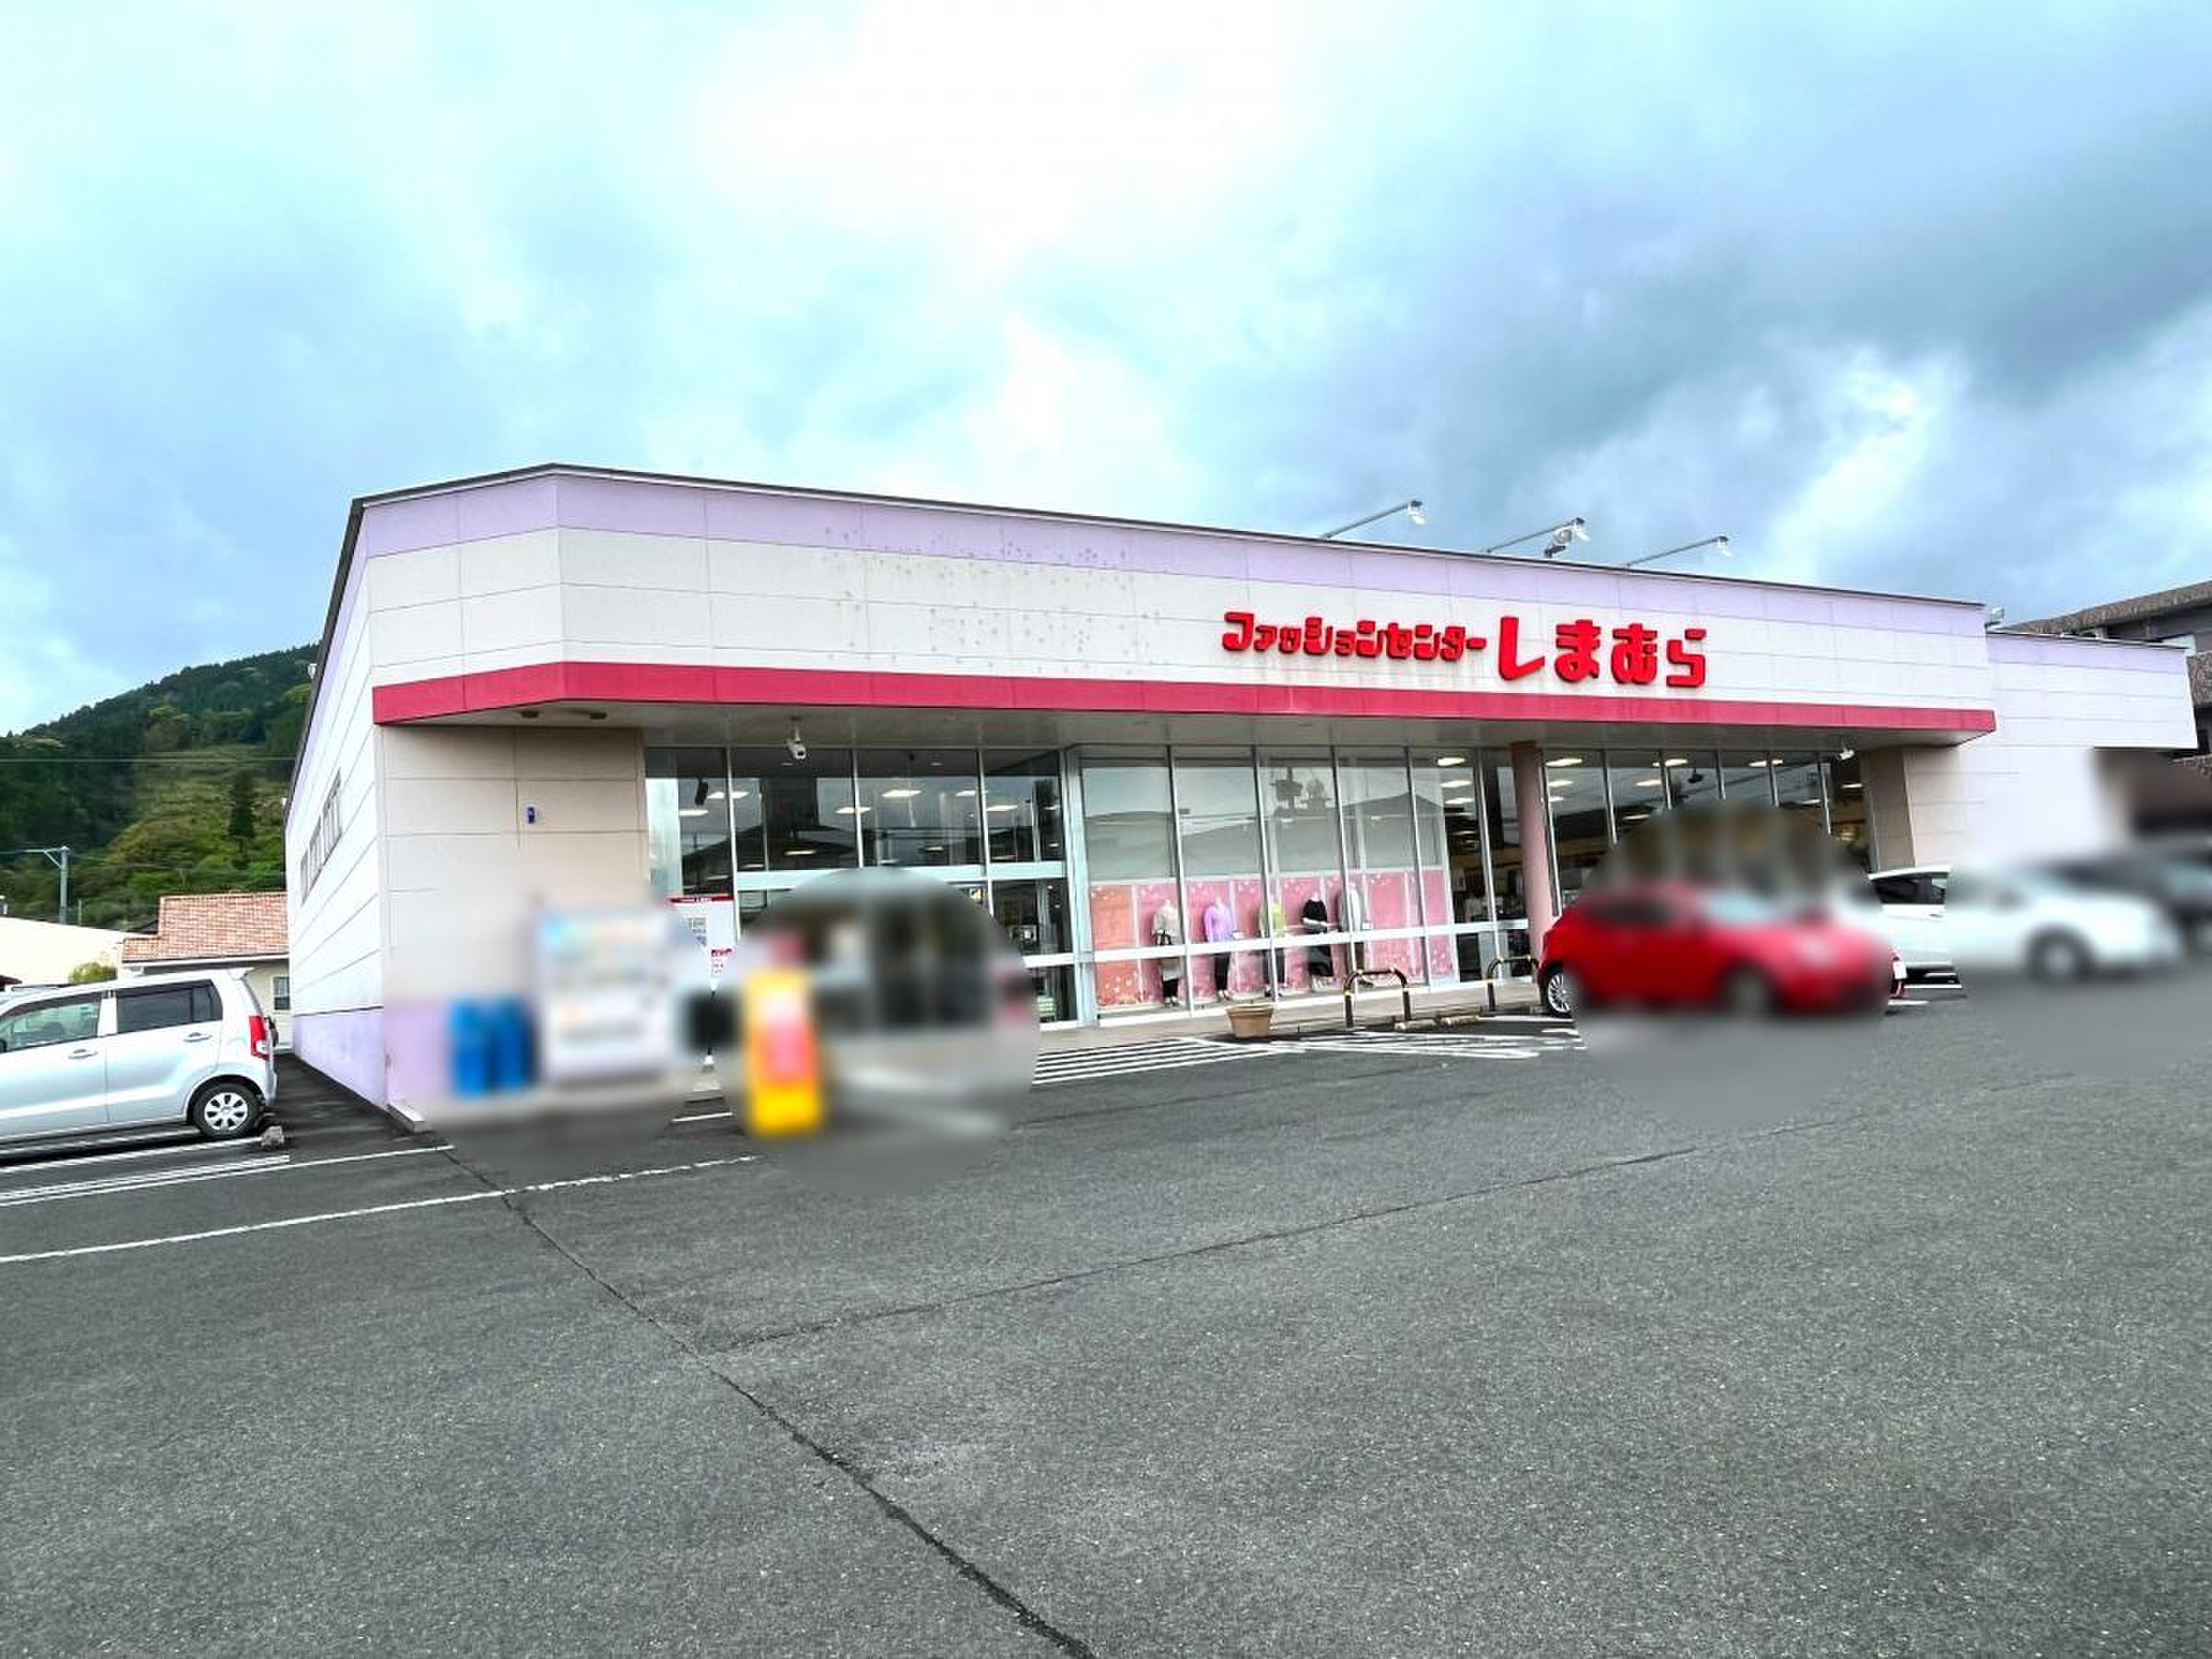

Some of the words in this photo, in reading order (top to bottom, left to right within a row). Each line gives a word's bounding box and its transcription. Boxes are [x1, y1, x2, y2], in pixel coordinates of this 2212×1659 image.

[1222, 611, 1487, 661] ファッションセンター
[1497, 615, 1706, 688] しまむら
